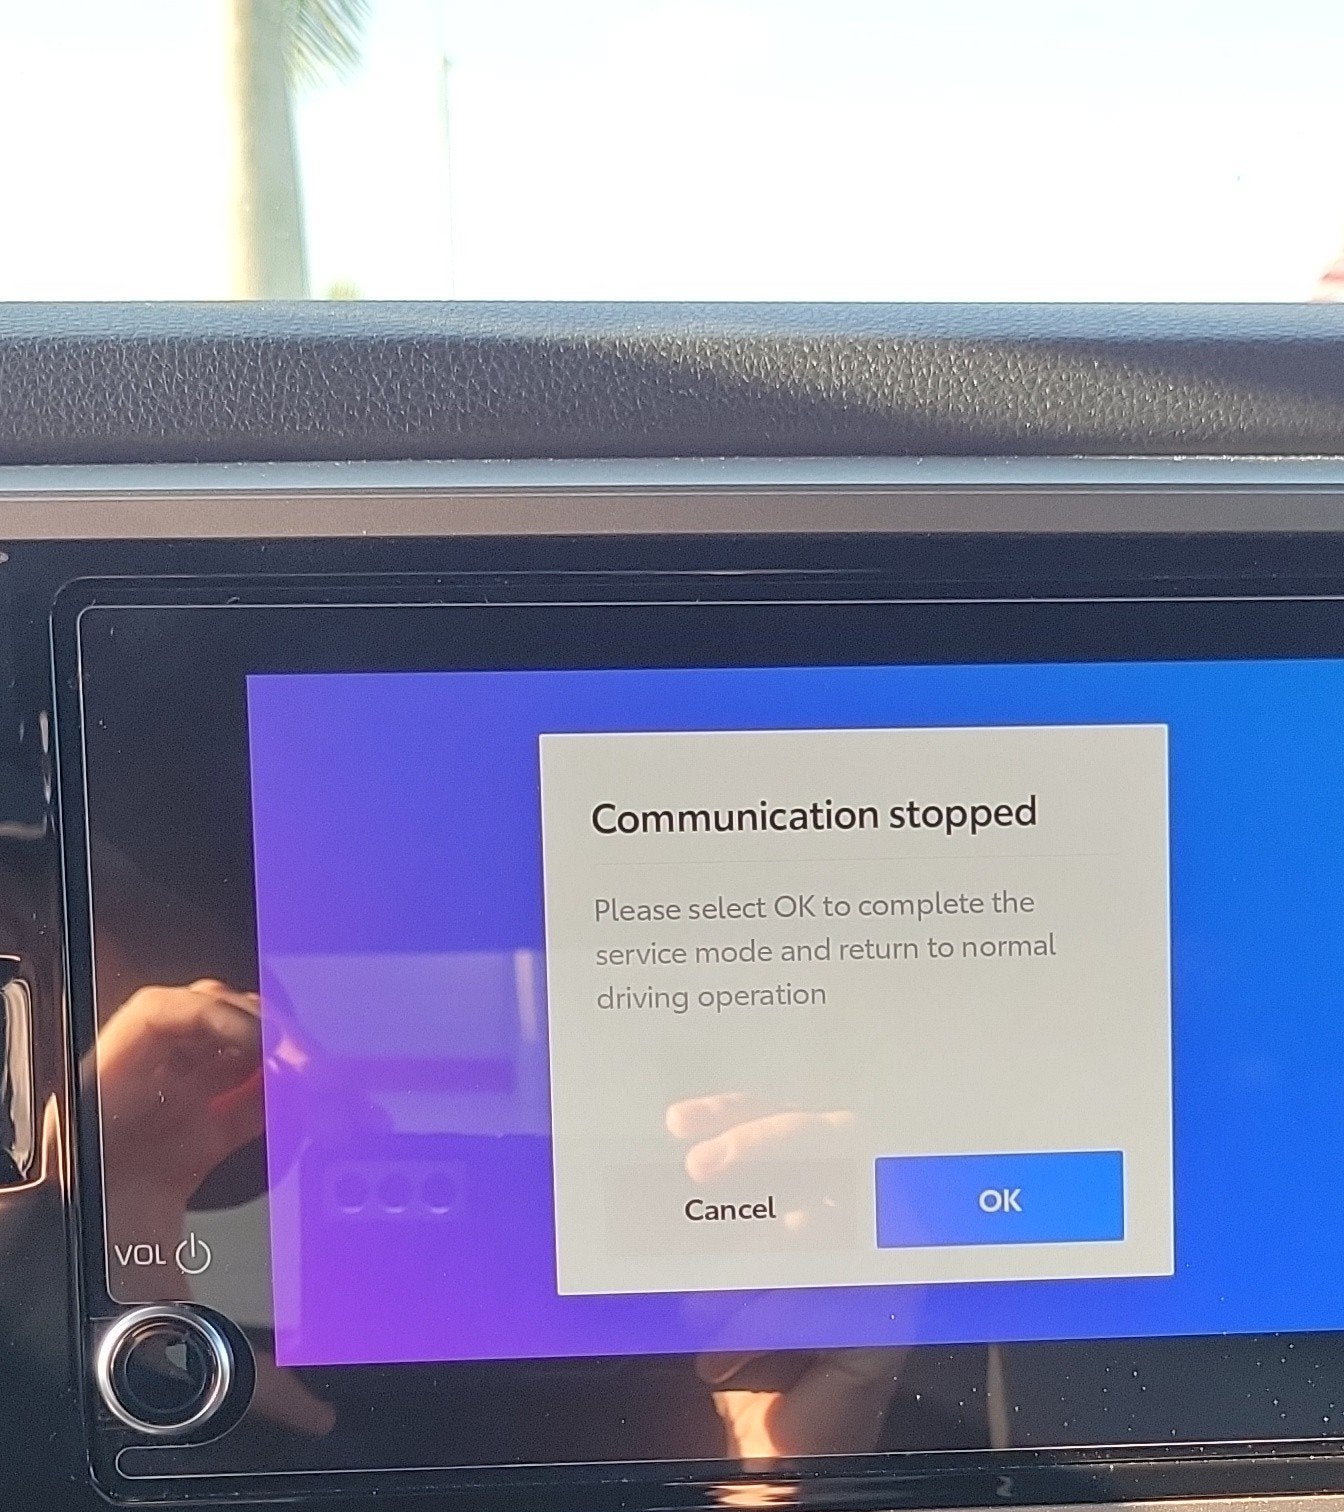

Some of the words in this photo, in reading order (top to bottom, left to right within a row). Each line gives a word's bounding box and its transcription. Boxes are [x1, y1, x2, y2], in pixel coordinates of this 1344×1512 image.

[592, 798, 880, 834] Communication
[889, 794, 1038, 835] stopped
[595, 898, 682, 922] Please
[688, 895, 767, 920] select
[774, 894, 816, 918] OK
[822, 897, 851, 917] to
[858, 891, 985, 922] complete
[991, 889, 1035, 913] the
[596, 942, 687, 966] service
[695, 938, 773, 963] mode
[781, 936, 831, 961] and
[839, 938, 918, 961] return
[927, 937, 954, 959] to
[962, 932, 1057, 958] normal
[597, 985, 689, 1014] driving
[698, 982, 827, 1013] operation
[684, 1196, 777, 1221] Cancel
[978, 1189, 1023, 1213] OK
[114, 1244, 167, 1266] VOL
